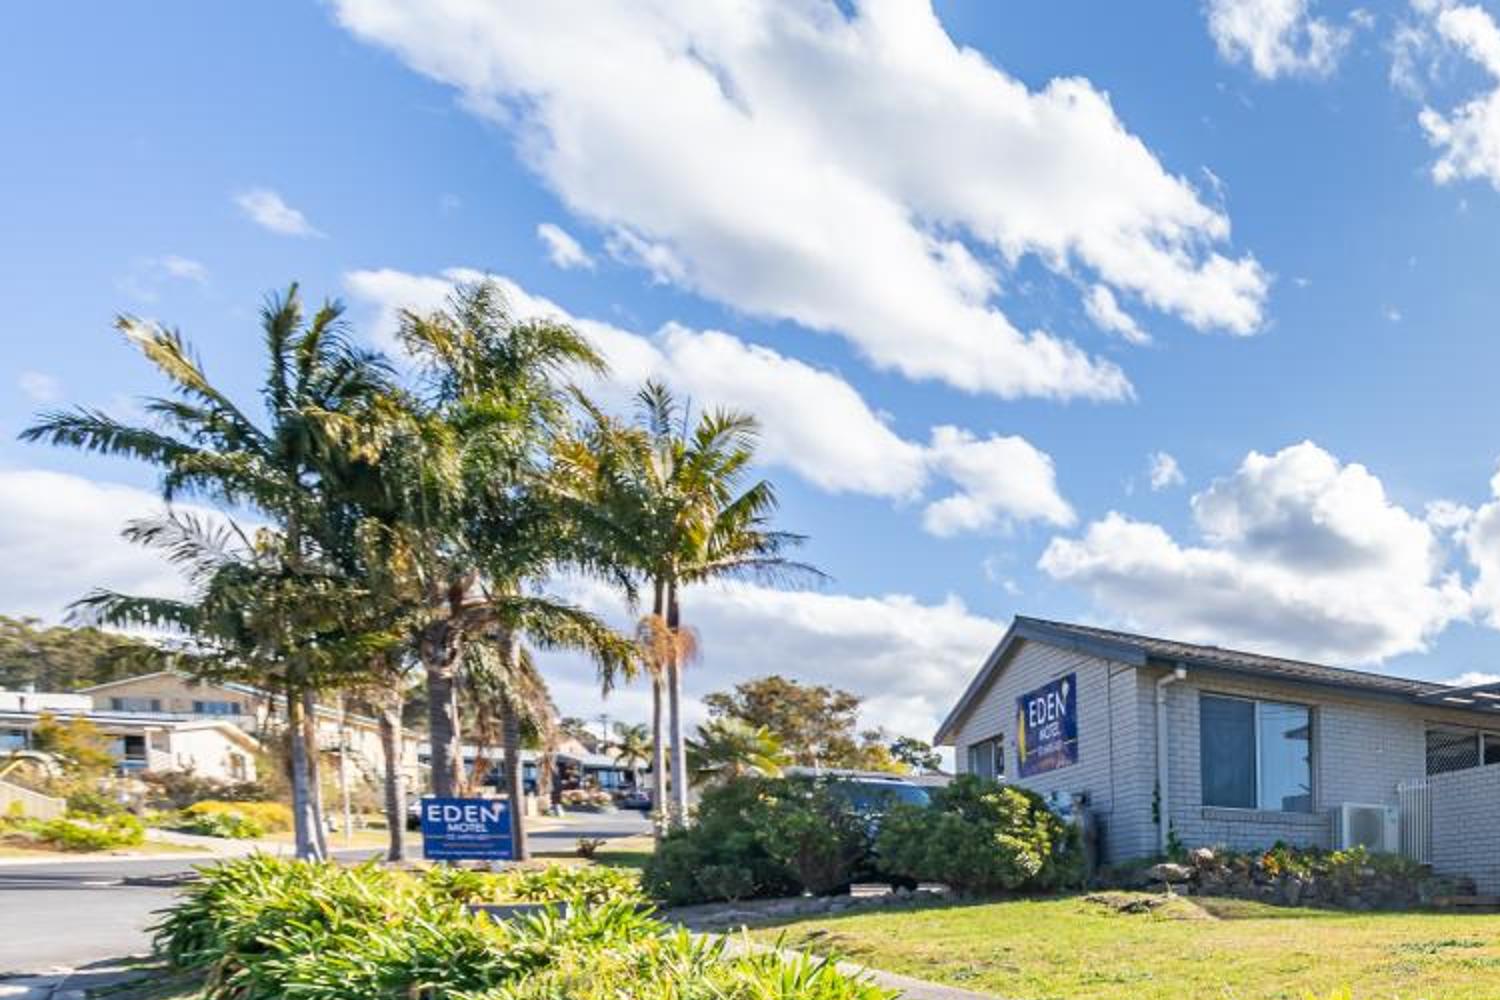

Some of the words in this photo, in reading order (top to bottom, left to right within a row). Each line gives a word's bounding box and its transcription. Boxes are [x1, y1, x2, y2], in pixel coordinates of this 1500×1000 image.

[1029, 690, 1067, 728] EDEN
[427, 804, 501, 823] EDEN
[446, 823, 488, 833] MOTEL
